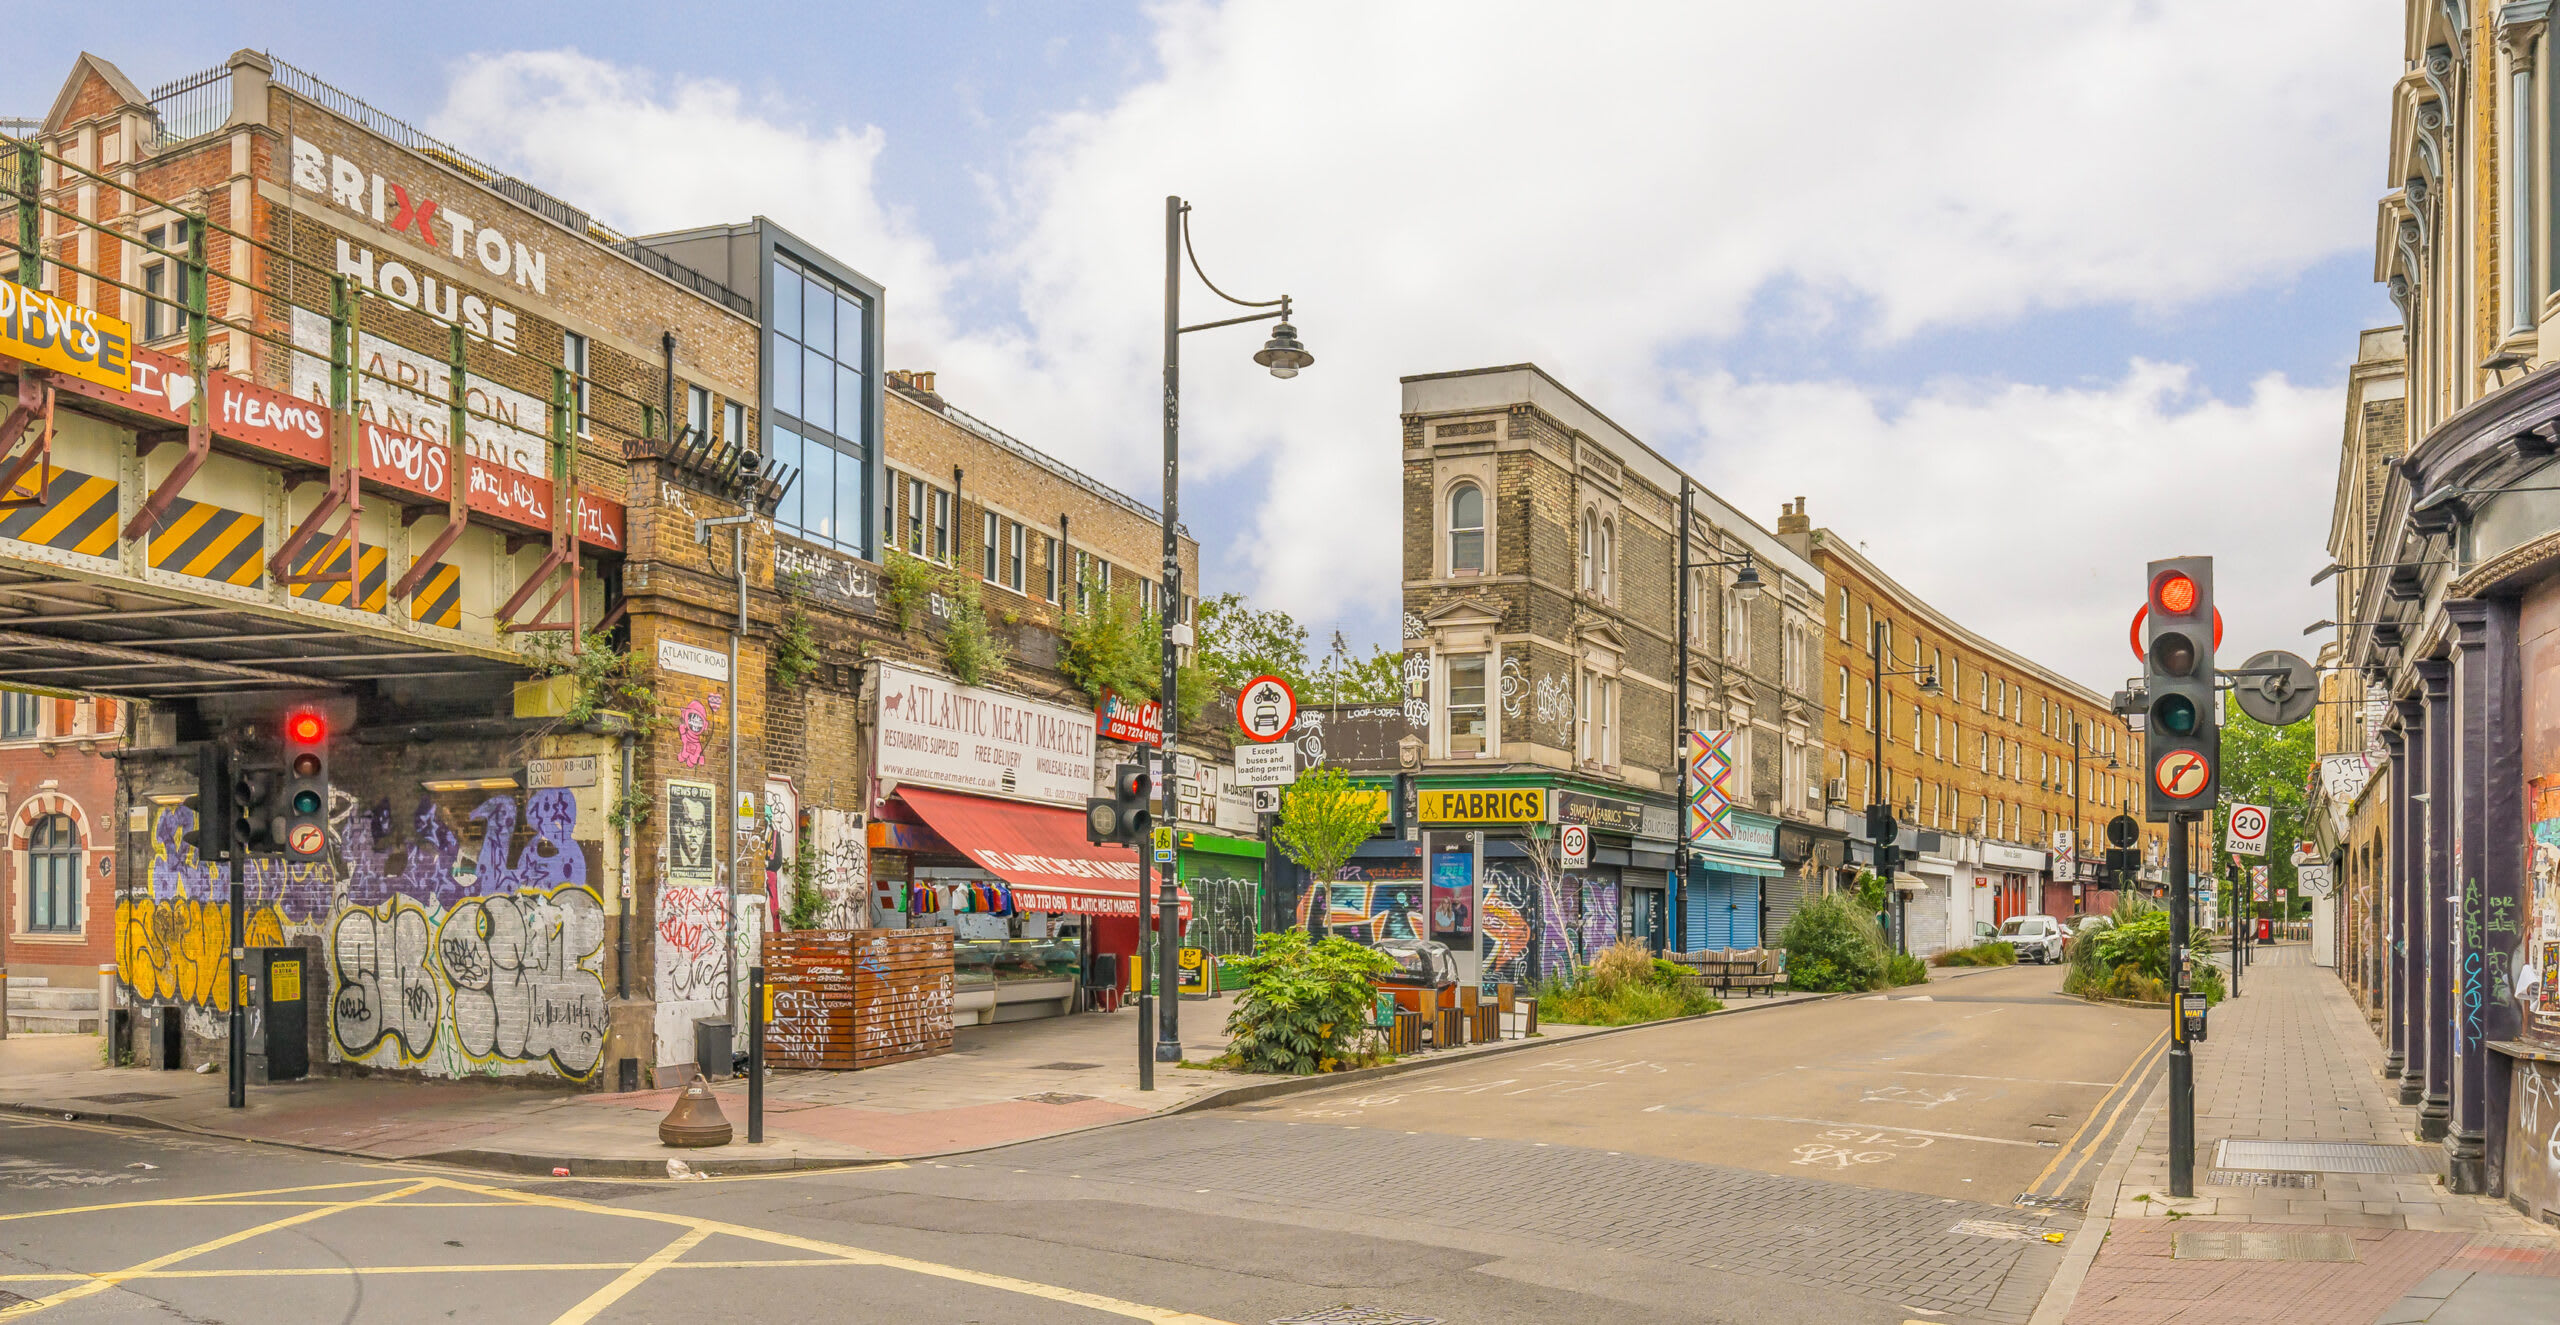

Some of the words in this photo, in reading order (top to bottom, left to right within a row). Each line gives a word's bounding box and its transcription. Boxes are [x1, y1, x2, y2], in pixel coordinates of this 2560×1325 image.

[292, 134, 547, 296] BRIXTON
[335, 237, 518, 357] HOUSE
[661, 645, 702, 666] ATLANTIC
[704, 654, 727, 669] ROAD
[883, 669, 892, 679] 53
[905, 684, 988, 738] ATLANTIC
[991, 703, 1034, 746] MEAT
[1035, 714, 1093, 758] MARKET
[1111, 722, 1126, 736] 020
[1127, 726, 1144, 740] 7274
[883, 728, 929, 754] RESTAURANTS
[929, 736, 960, 759] SUPPLIED
[1252, 747, 1278, 756] Except
[974, 744, 991, 763] FREE
[992, 748, 1023, 769] DELIVERY
[1246, 756, 1265, 765] buses
[1269, 756, 1284, 764] and
[529, 760, 594, 774] COLDHARBUR
[882, 763, 996, 788] www.atlanticmeatmarket.co.uk
[1036, 756, 1067, 777] WHOLESALE
[1067, 765, 1073, 778] &
[1073, 766, 1091, 781] RETAIL
[1237, 765, 1266, 775] loading
[1267, 764, 1293, 773] permit
[529, 773, 553, 786] LANE
[1250, 775, 1279, 783] holders
[671, 785, 692, 798] NEWS
[1441, 792, 1539, 819] FABRICS
[1569, 803, 1593, 820] SIMPLY
[1596, 808, 1622, 824] FABRICS
[1643, 818, 1679, 836] SOLICITORS
[2237, 815, 2262, 830] 20
[1566, 835, 1583, 847] 20
[1731, 824, 1773, 846] Wholefoods
[2229, 840, 2262, 852] ZONE
[974, 848, 1066, 876] ATLANTIC
[1048, 856, 1104, 879] MEAT
[1563, 857, 1585, 865] ZONE
[1023, 893, 1036, 909] 020
[1071, 896, 1097, 912] ATLANTIC
[1097, 897, 1114, 913] MEAT
[1114, 899, 1138, 914] MARKET
[2184, 1009, 2205, 1018] WAIT
